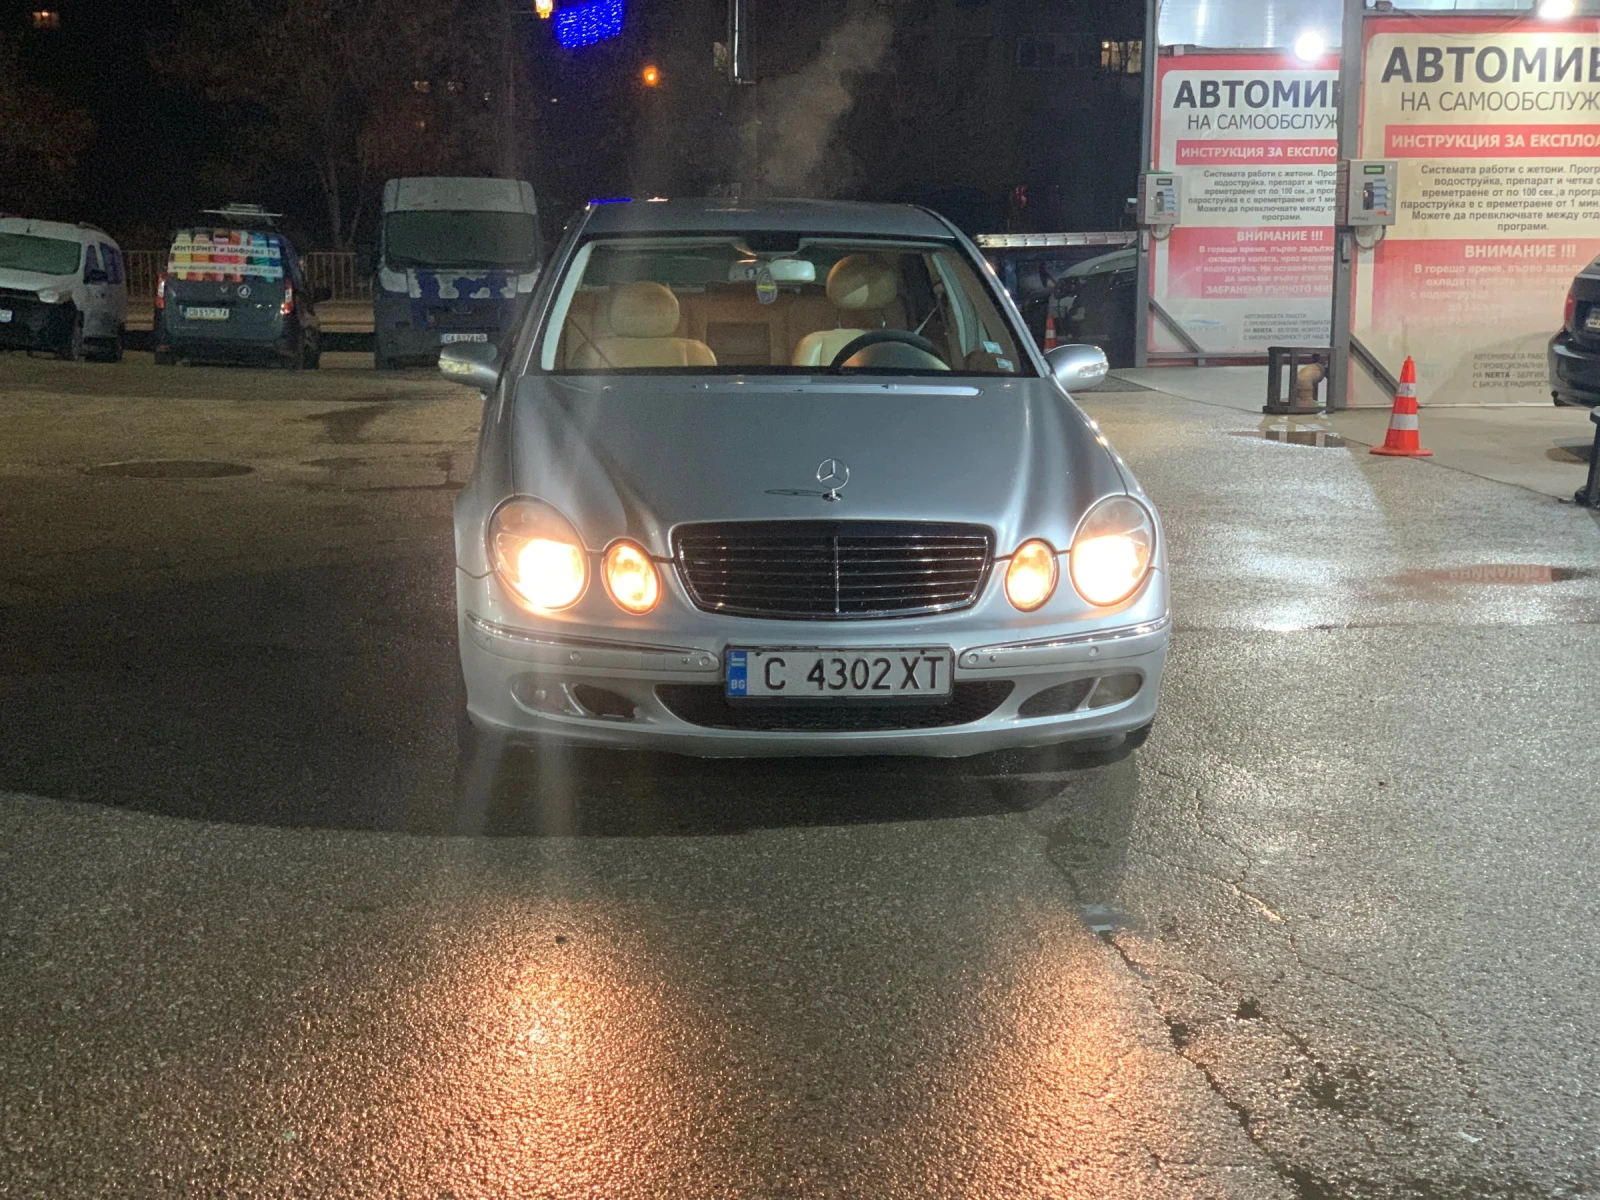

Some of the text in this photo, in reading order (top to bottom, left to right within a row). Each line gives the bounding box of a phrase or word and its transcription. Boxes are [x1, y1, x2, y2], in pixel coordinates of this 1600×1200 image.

[1173, 79, 1339, 109] АВТОМИ
[1401, 91, 1600, 111] НА САМООБСЛУЖ
[1187, 114, 1211, 130] НА
[1391, 134, 1500, 150] ИНСТРУКЦИЯ
[1504, 133, 1525, 147] ЗА
[1181, 146, 1337, 159] ИНСТРУКЦИЯ ЗА ЕКСПЛО
[1203, 170, 1246, 178] Системата
[1247, 169, 1276, 179] работи
[1421, 165, 1476, 174] Системата
[1479, 164, 1516, 176] работи
[1518, 166, 1524, 174] с
[1527, 166, 1566, 174] жетони.
[1268, 179, 1305, 187] препарат
[1434, 176, 1503, 187] водоструйка,
[1506, 177, 1554, 187] препарат
[1556, 177, 1563, 185] и
[1566, 177, 1594, 185] четка
[1204, 188, 1256, 196] времетраене
[1281, 187, 1292, 195] 100
[1422, 188, 1489, 198] времетраене
[1492, 189, 1504, 197] от
[1506, 189, 1519, 197] по
[1522, 187, 1537, 197] 100
[1188, 196, 1238, 204] пароструйка
[1253, 196, 1305, 204] времетраене
[1400, 200, 1466, 210] пароструйка
[1486, 199, 1553, 209] времетраене
[1555, 200, 1566, 208] от
[1570, 199, 1575, 207] 1
[1240, 205, 1297, 213] превключвате
[1299, 205, 1325, 213] между
[1262, 213, 1302, 221] програми.
[1412, 211, 1451, 220] Можете
[1453, 212, 1466, 220] да
[1469, 211, 1543, 220] превключвате
[1546, 211, 1578, 221] между
[1497, 222, 1550, 232] програми.
[1236, 230, 1323, 241] ВНИМАНИЕ !!!
[1199, 245, 1205, 253] В
[1207, 246, 1237, 254] горещо
[1464, 244, 1576, 258] ВНИМАНИЕ !!!
[1414, 264, 1422, 273] В
[1425, 265, 1465, 275] горещо
[764, 657, 786, 690] C
[730, 679, 745, 690] BG
